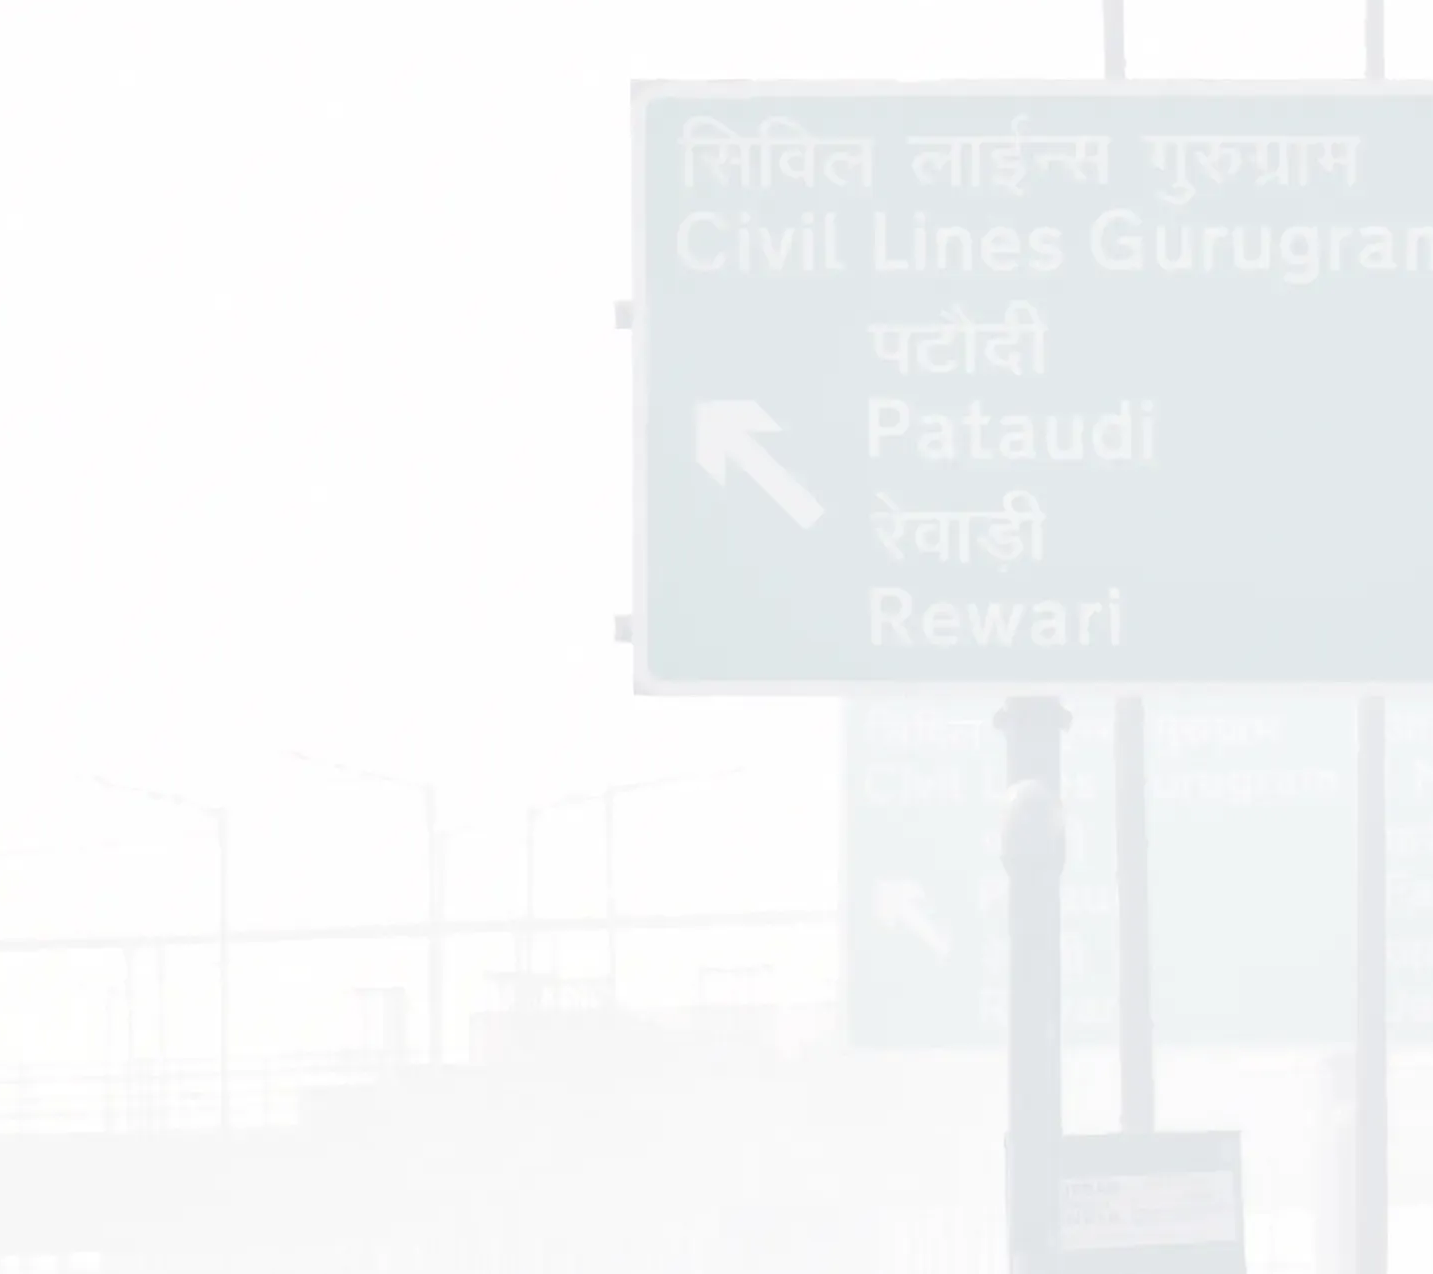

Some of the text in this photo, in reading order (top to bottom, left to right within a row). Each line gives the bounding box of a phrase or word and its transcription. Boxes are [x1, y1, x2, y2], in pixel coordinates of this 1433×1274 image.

[679, 116, 873, 190] सिविल
[1141, 134, 1361, 205] गुरुग्राम
[675, 211, 844, 272] Civil
[873, 211, 1064, 273] Lines
[868, 301, 1048, 377] पटौदी
[868, 398, 1154, 462] Pataudi
[869, 587, 1121, 646] Rewari
[1152, 768, 1339, 808] urugram
